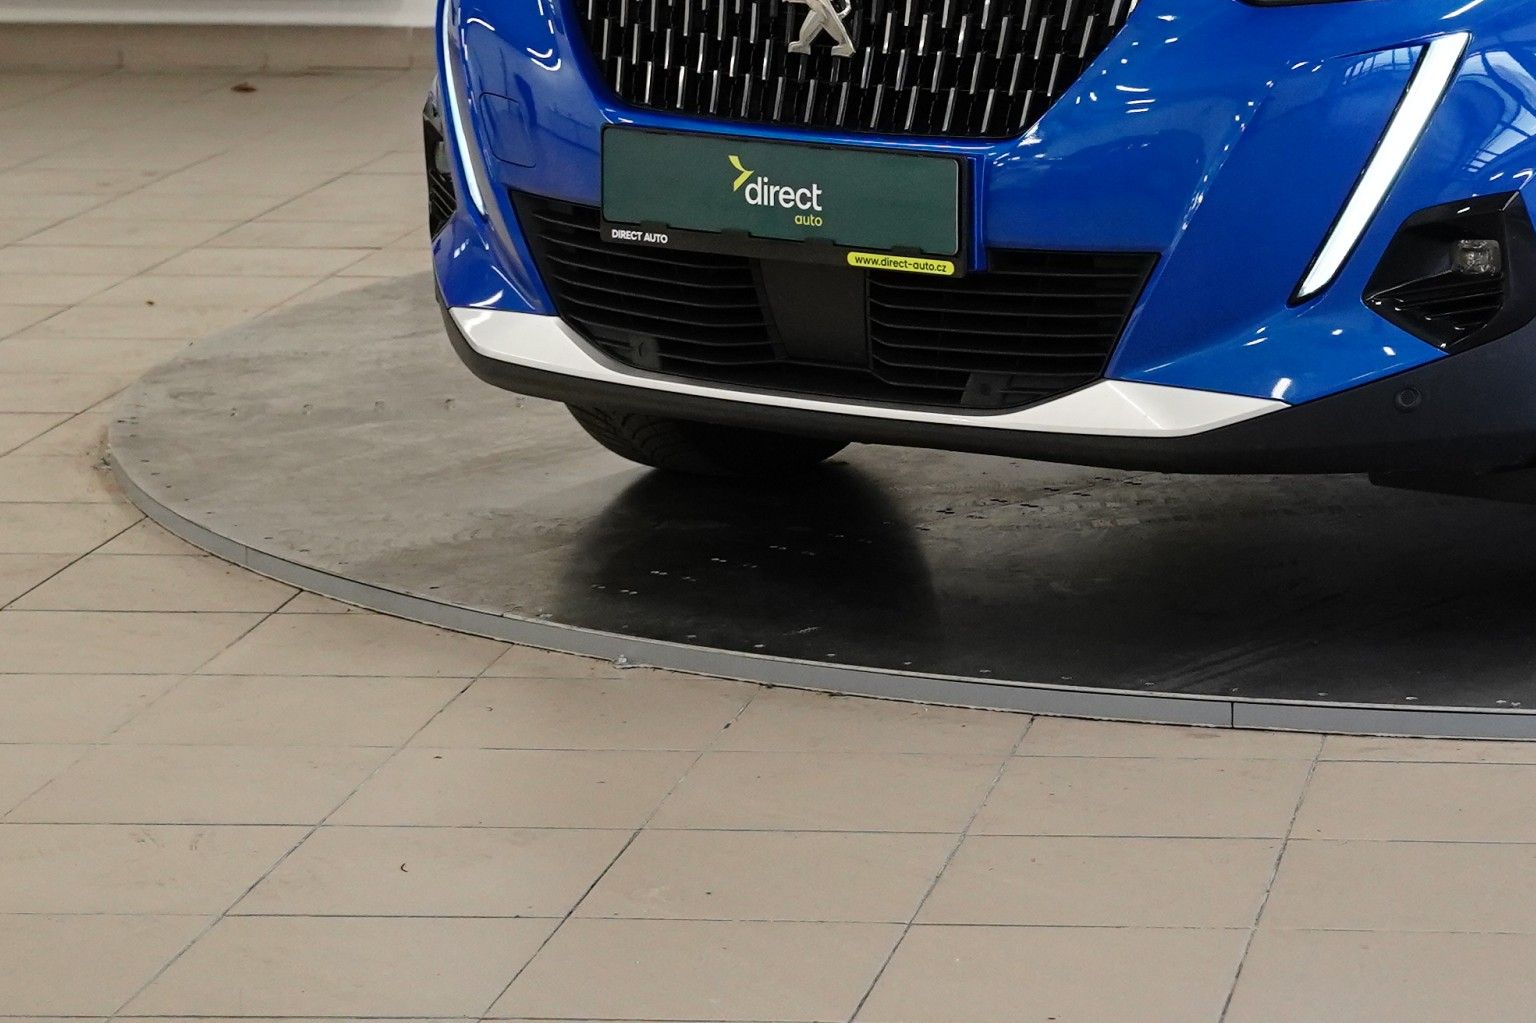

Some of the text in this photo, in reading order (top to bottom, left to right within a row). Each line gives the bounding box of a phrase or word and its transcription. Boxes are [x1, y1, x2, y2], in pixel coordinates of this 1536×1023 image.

[745, 177, 822, 211] direct
[794, 213, 823, 227] auto
[611, 228, 668, 244] DIRECT AUTO
[854, 255, 947, 274] www.direct-auto.cz
